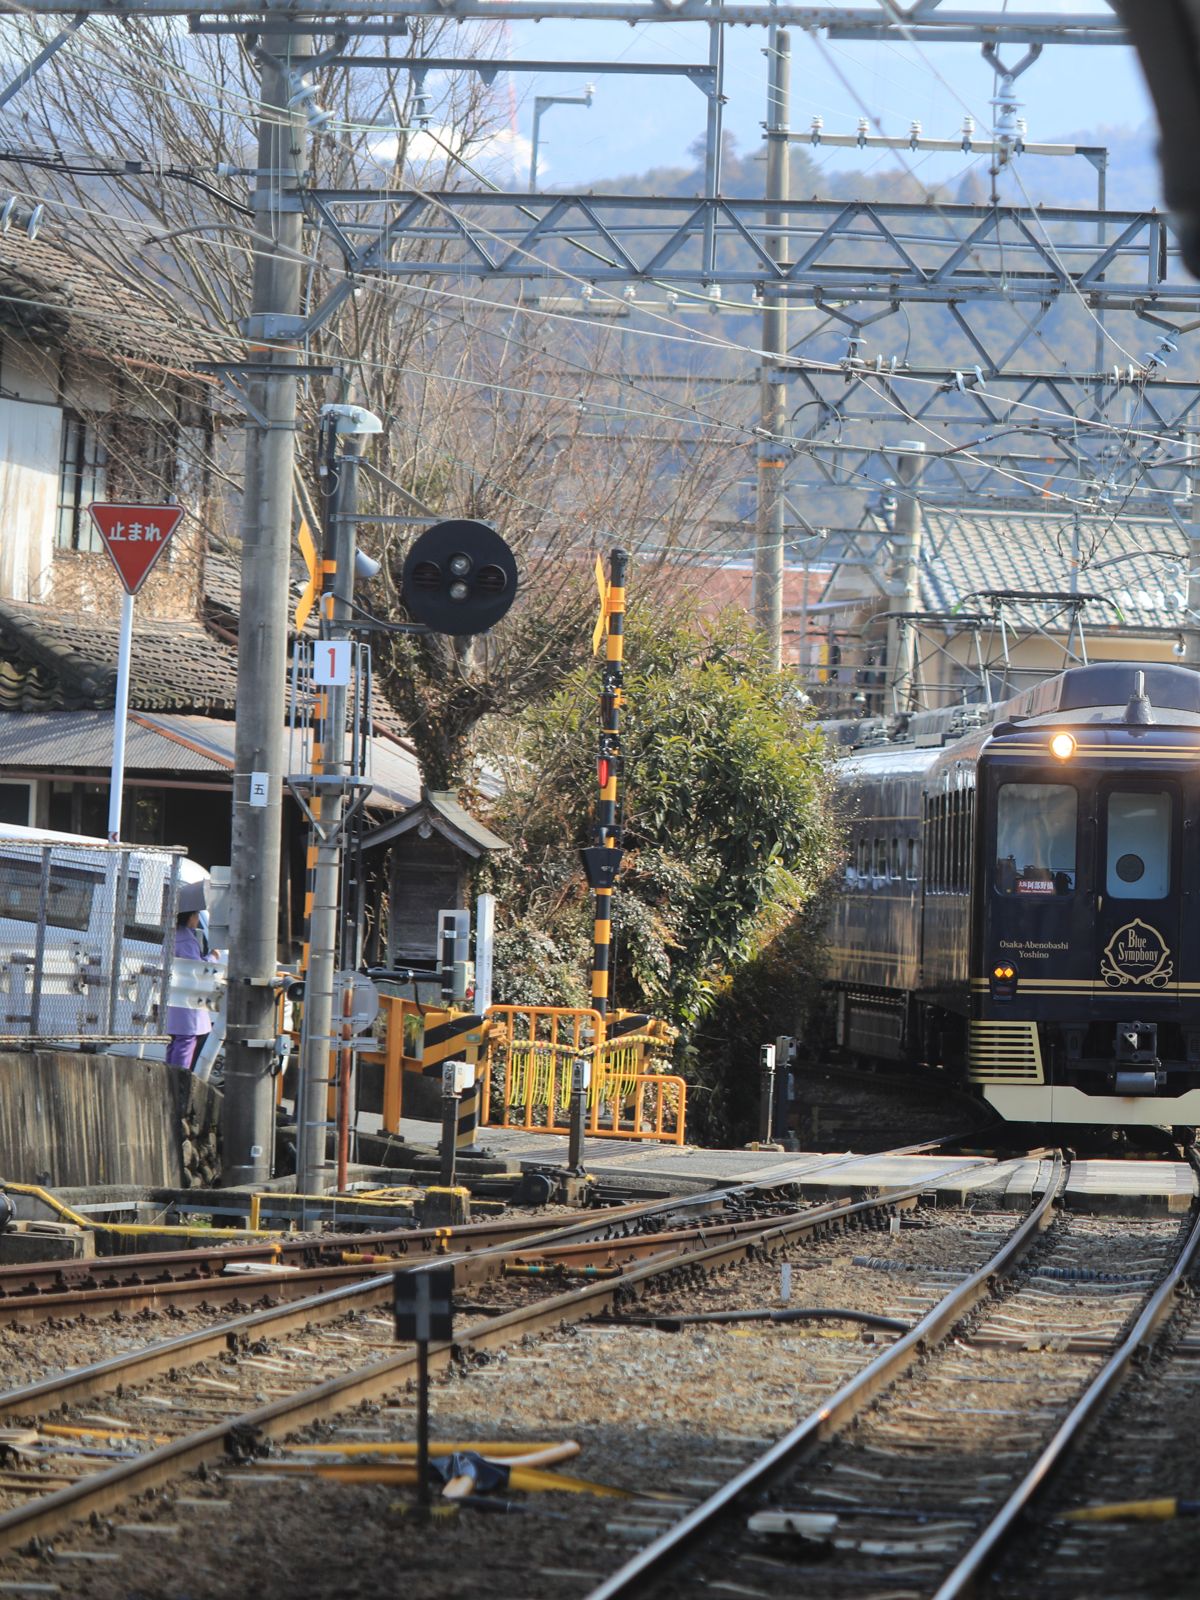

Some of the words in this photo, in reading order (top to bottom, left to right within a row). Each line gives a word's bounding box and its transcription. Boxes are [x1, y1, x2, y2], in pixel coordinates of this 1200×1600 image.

[108, 521, 162, 542] 止まれ
[327, 647, 336, 679] 1
[253, 783, 265, 796] 五
[999, 940, 1069, 951] Osaka-Abenobashi
[1127, 928, 1147, 948] Blue
[1018, 950, 1049, 959] Yoshino
[1118, 941, 1159, 963] Symphony
